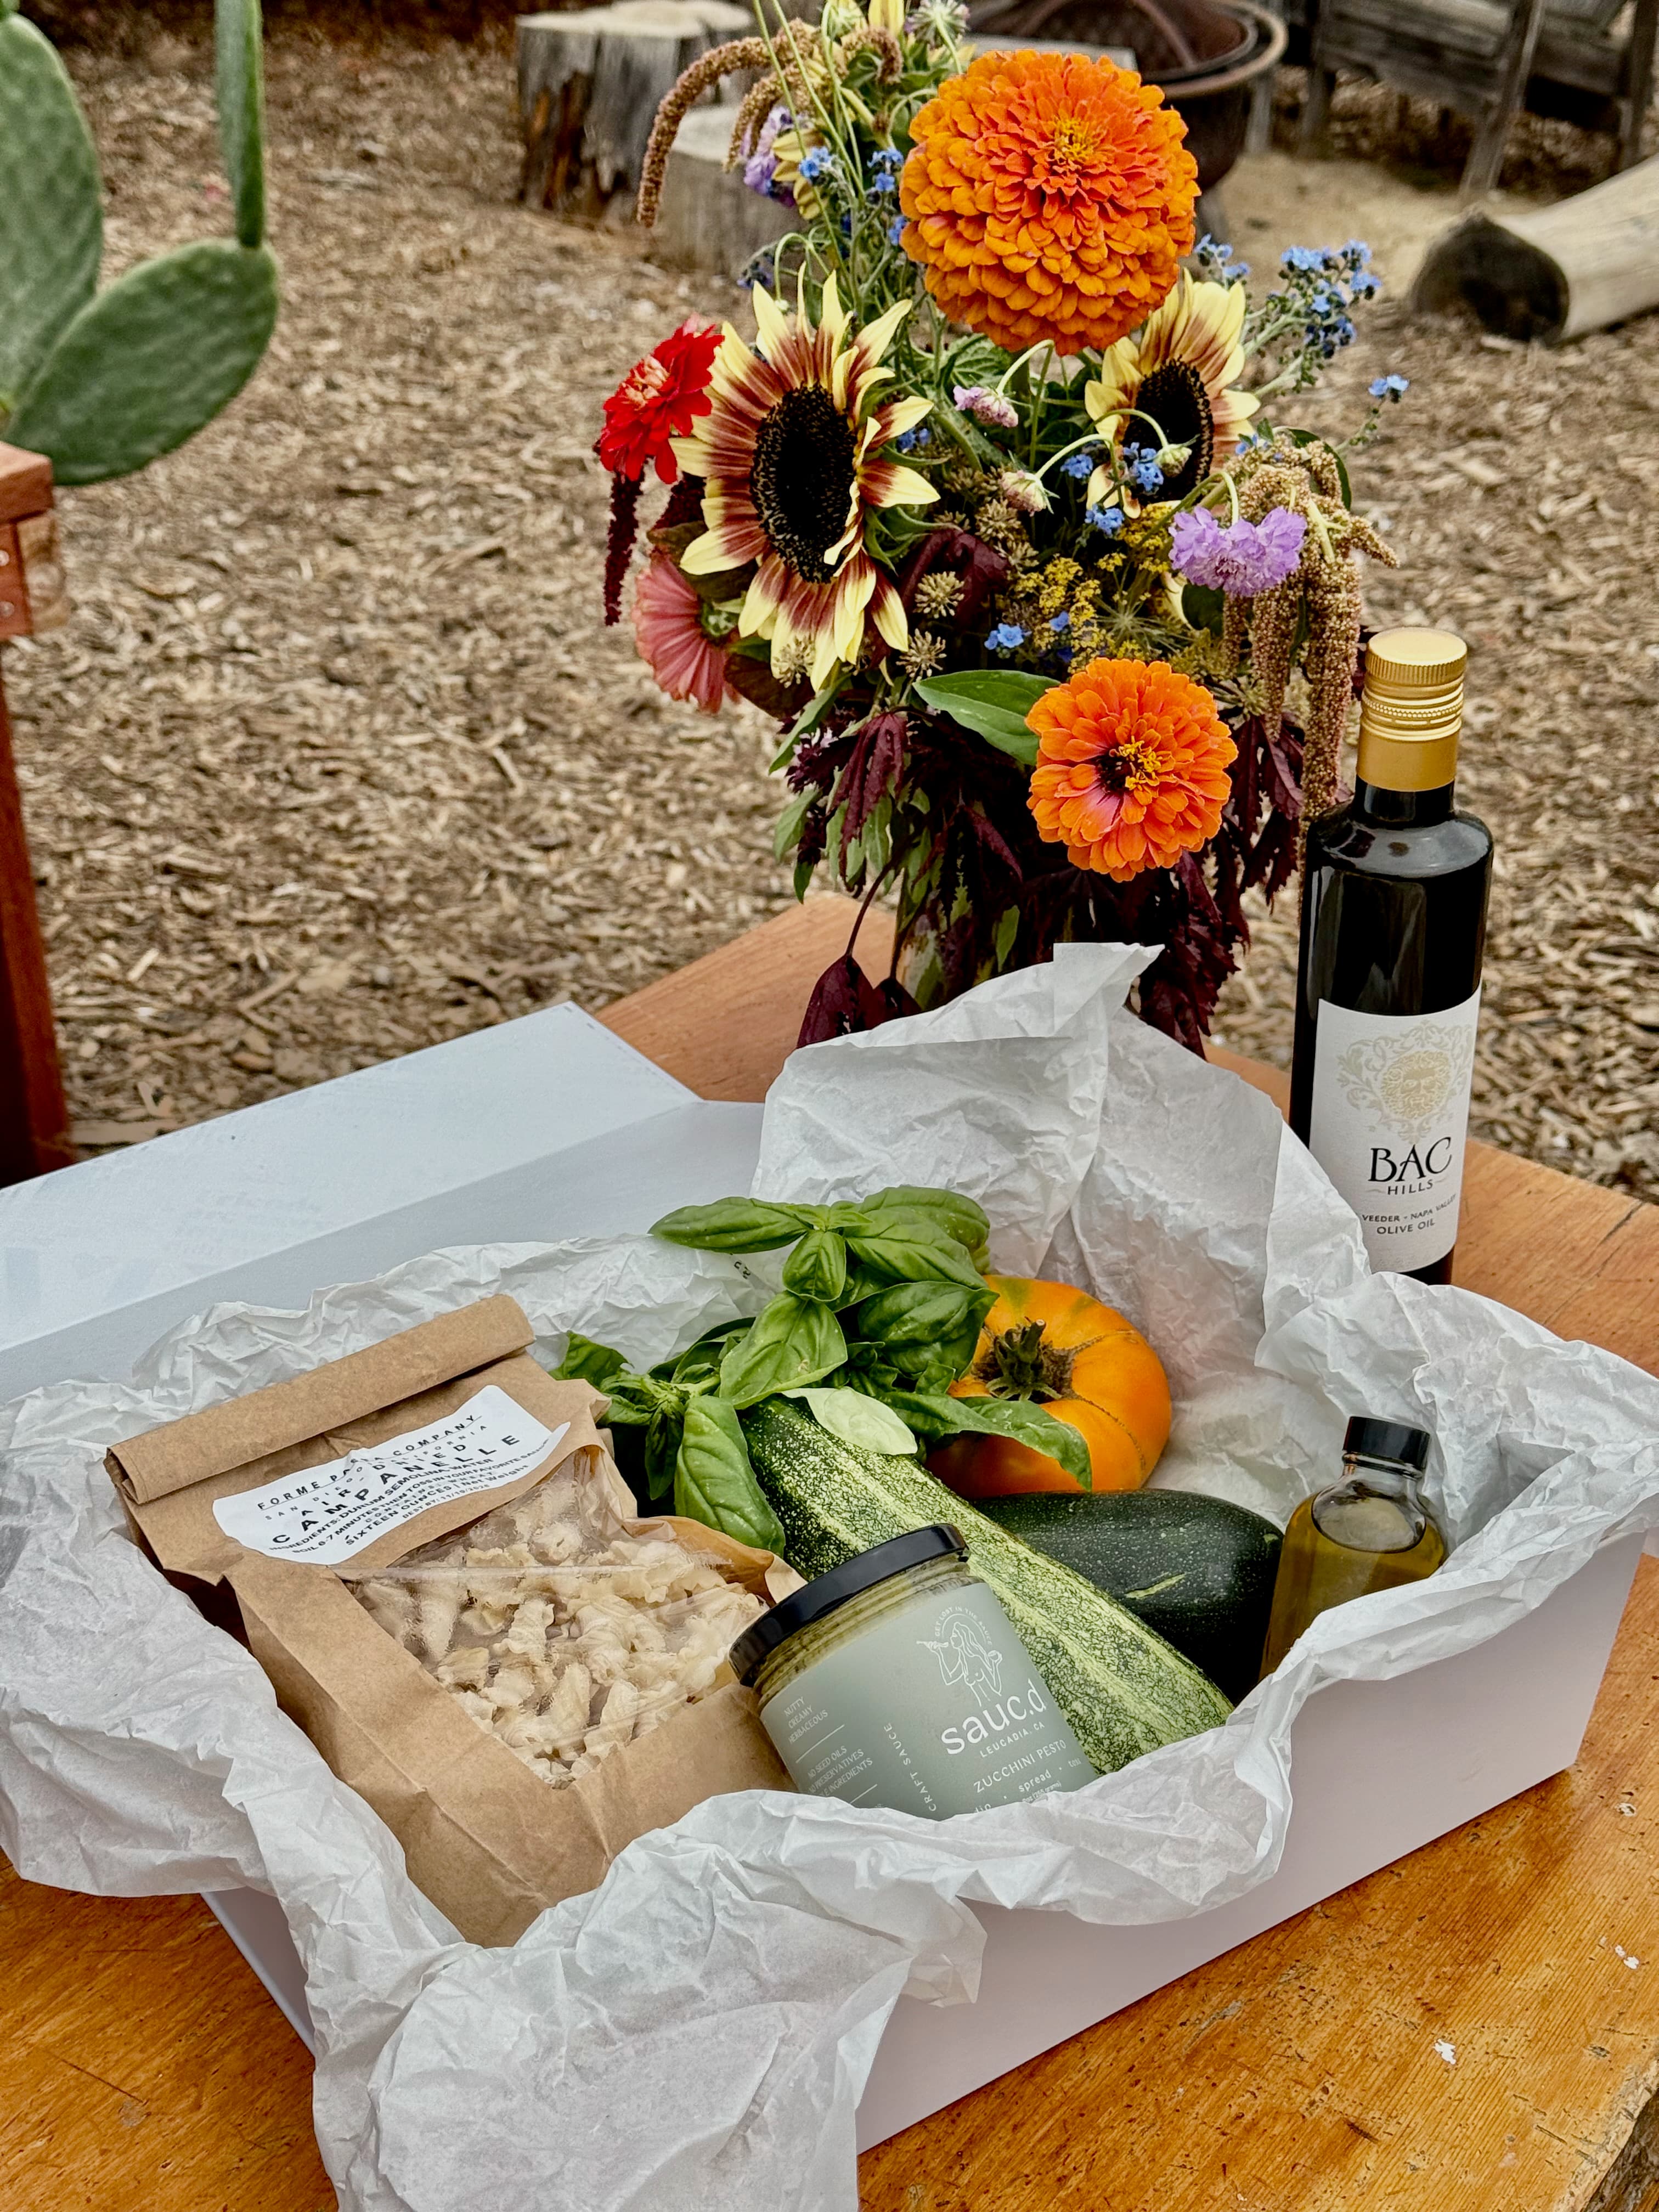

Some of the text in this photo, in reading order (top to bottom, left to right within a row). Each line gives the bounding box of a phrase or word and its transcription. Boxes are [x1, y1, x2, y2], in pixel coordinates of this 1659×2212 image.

[1368, 1137, 1452, 1182] BAC
[1387, 1179, 1434, 1195] HILLS
[1362, 1214, 1400, 1222] VEEDER
[1410, 1209, 1434, 1220] NAPA
[1435, 1194, 1457, 1211] VALLEY
[1376, 1218, 1436, 1234] OLIVE OIL
[258, 1481, 320, 1510] FORME
[393, 1415, 475, 1456] COMPANY
[273, 1435, 520, 1543] CAMPANELLE
[335, 1508, 380, 1535] MINUTES
[379, 1493, 408, 1508] THEN
[405, 1480, 433, 1492] TOSS
[444, 1470, 473, 1480] YOUR
[473, 1458, 522, 1473] FAVORITE
[339, 1495, 385, 1518] DURUM
[450, 1459, 494, 1470] WATER
[346, 1510, 399, 1545] SIXTEEN
[401, 1485, 452, 1510] OUNCES
[484, 1465, 528, 1481] Weight
[265, 1505, 298, 1520] SAN
[403, 1505, 424, 1519] BEST
[784, 1696, 805, 1717] NUTTY
[788, 1705, 812, 1729] CREAMY
[941, 1678, 1047, 1755] sauc.d
[788, 1709, 828, 1745] HERBACEOUS
[1033, 1721, 1045, 1730] CA
[807, 1745, 847, 1779] NO SEED OILS
[814, 1748, 864, 1790] PRESERVATIVES
[828, 1757, 873, 1793] INGREDIENTS
[883, 1723, 937, 1812] CRAFT SAUCE
[973, 1739, 1067, 1793] ZUCCHINI PESTO
[1018, 1768, 1052, 1792] spread
